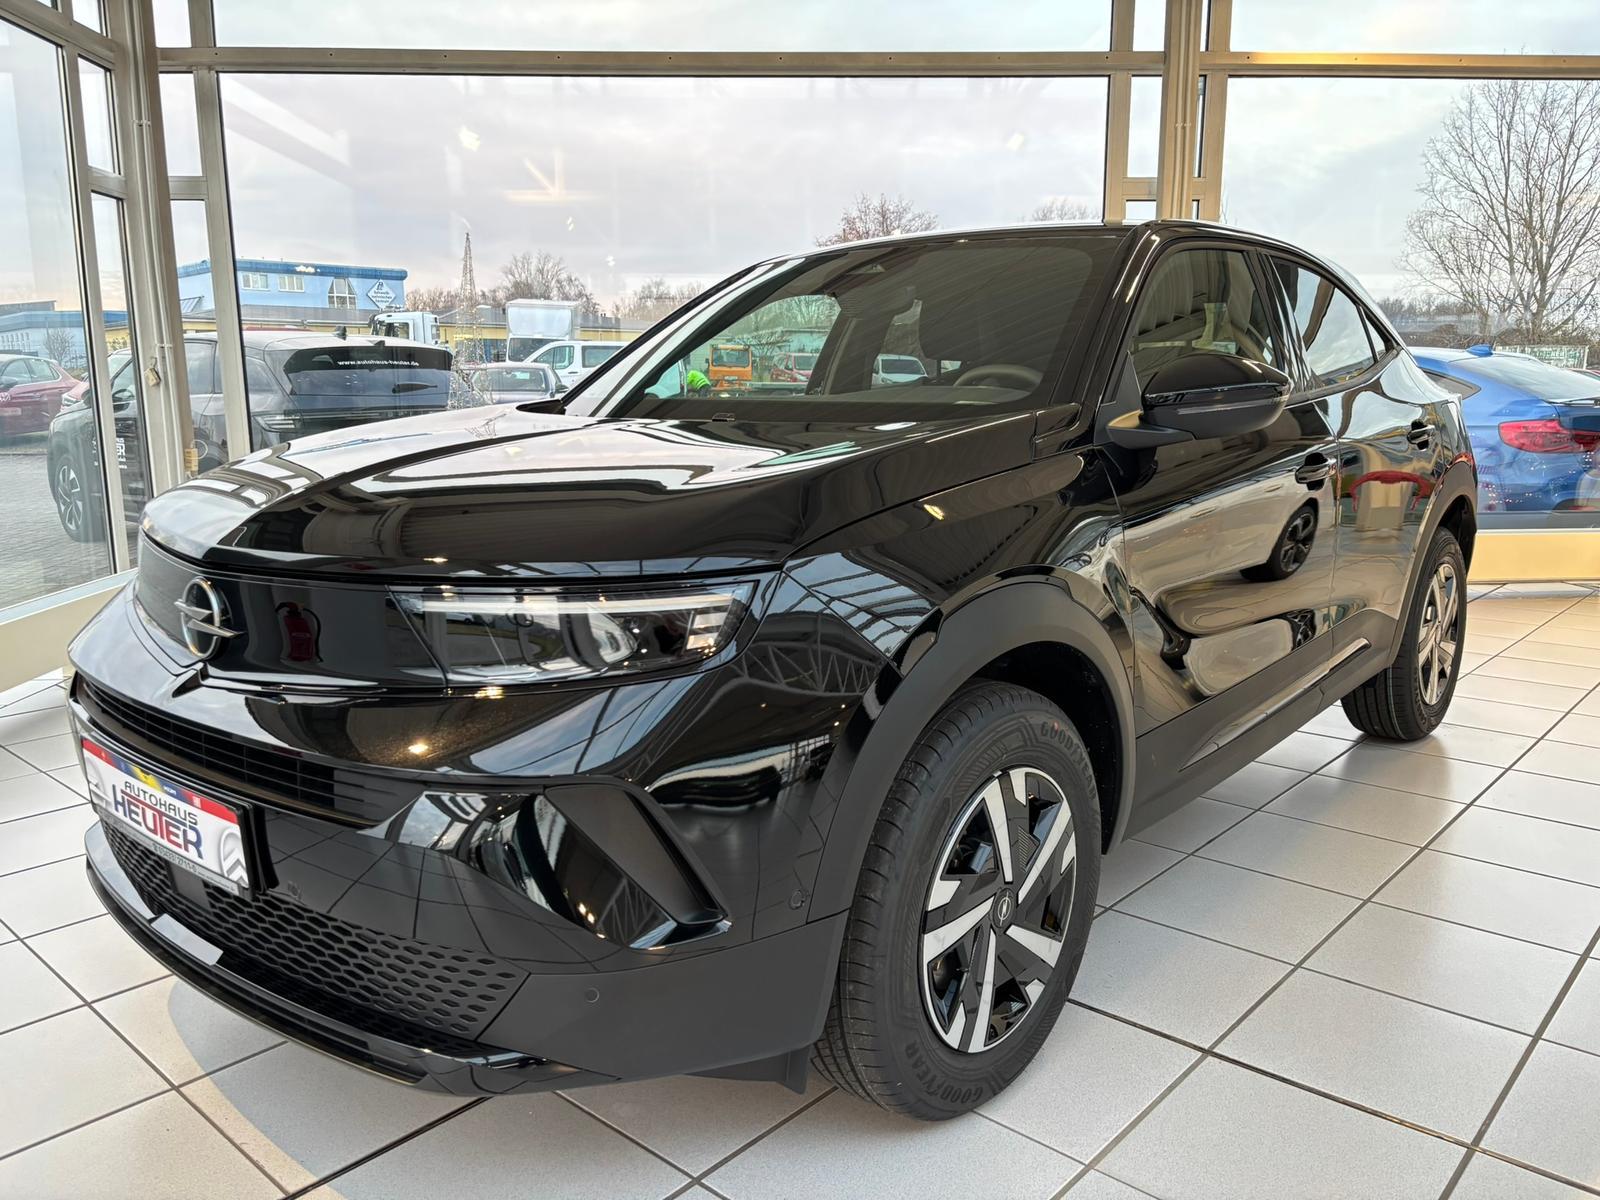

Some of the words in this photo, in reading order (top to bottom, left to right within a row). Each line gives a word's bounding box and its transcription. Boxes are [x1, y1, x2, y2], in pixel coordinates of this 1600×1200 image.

[1040, 720, 1097, 801] GOODYEAR
[112, 784, 204, 860] HEUTER
[124, 780, 199, 826] AUTOHAUS
[904, 1040, 984, 1104] GOODYEAR
